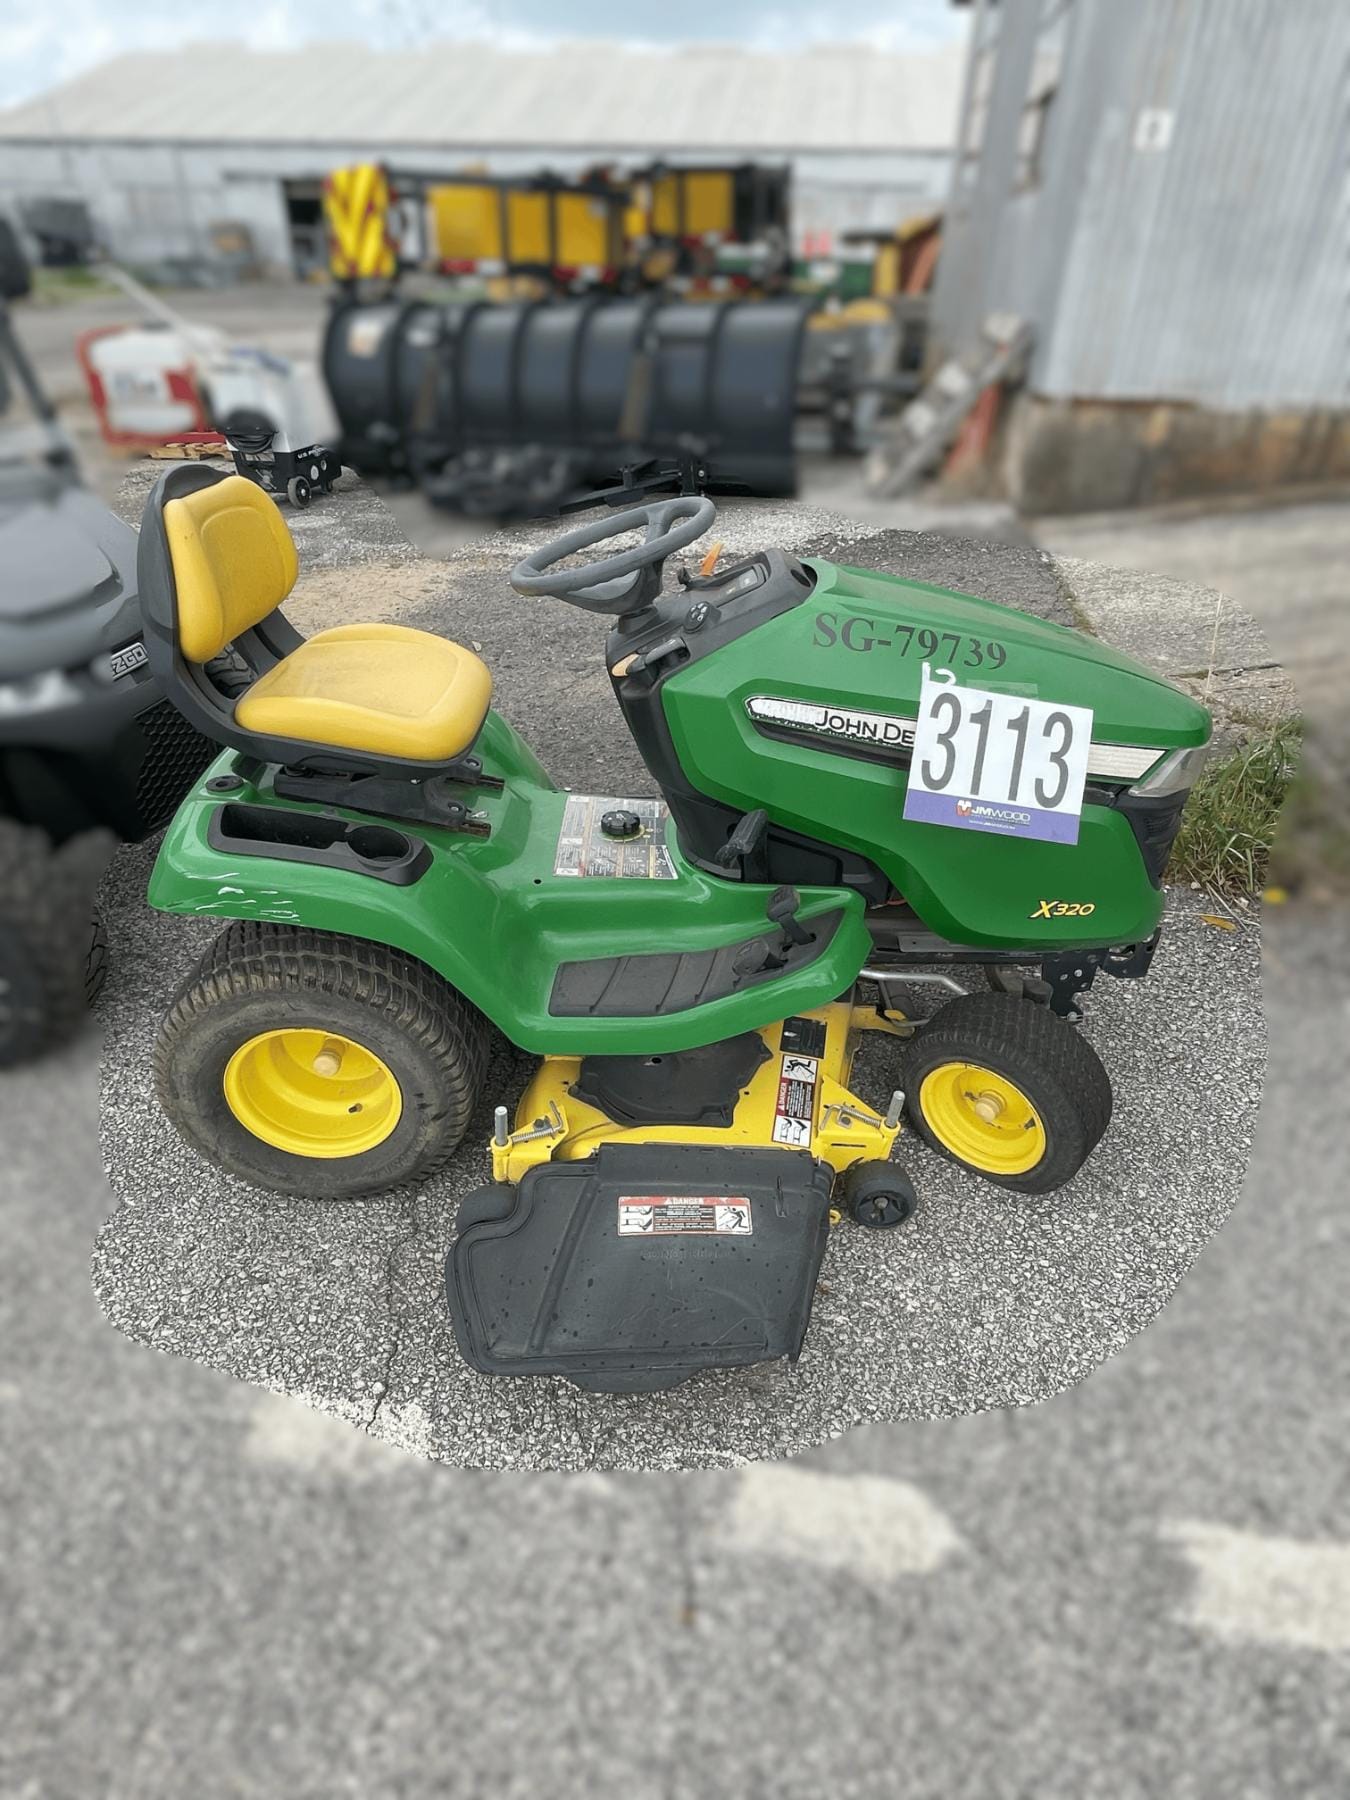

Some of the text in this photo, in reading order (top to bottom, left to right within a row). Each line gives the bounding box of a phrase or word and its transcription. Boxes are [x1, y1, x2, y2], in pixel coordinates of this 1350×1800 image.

[812, 612, 1007, 670] SG-79739
[815, 710, 878, 738] JOHN
[921, 692, 1074, 809] 3113
[1029, 900, 1096, 918] X320
